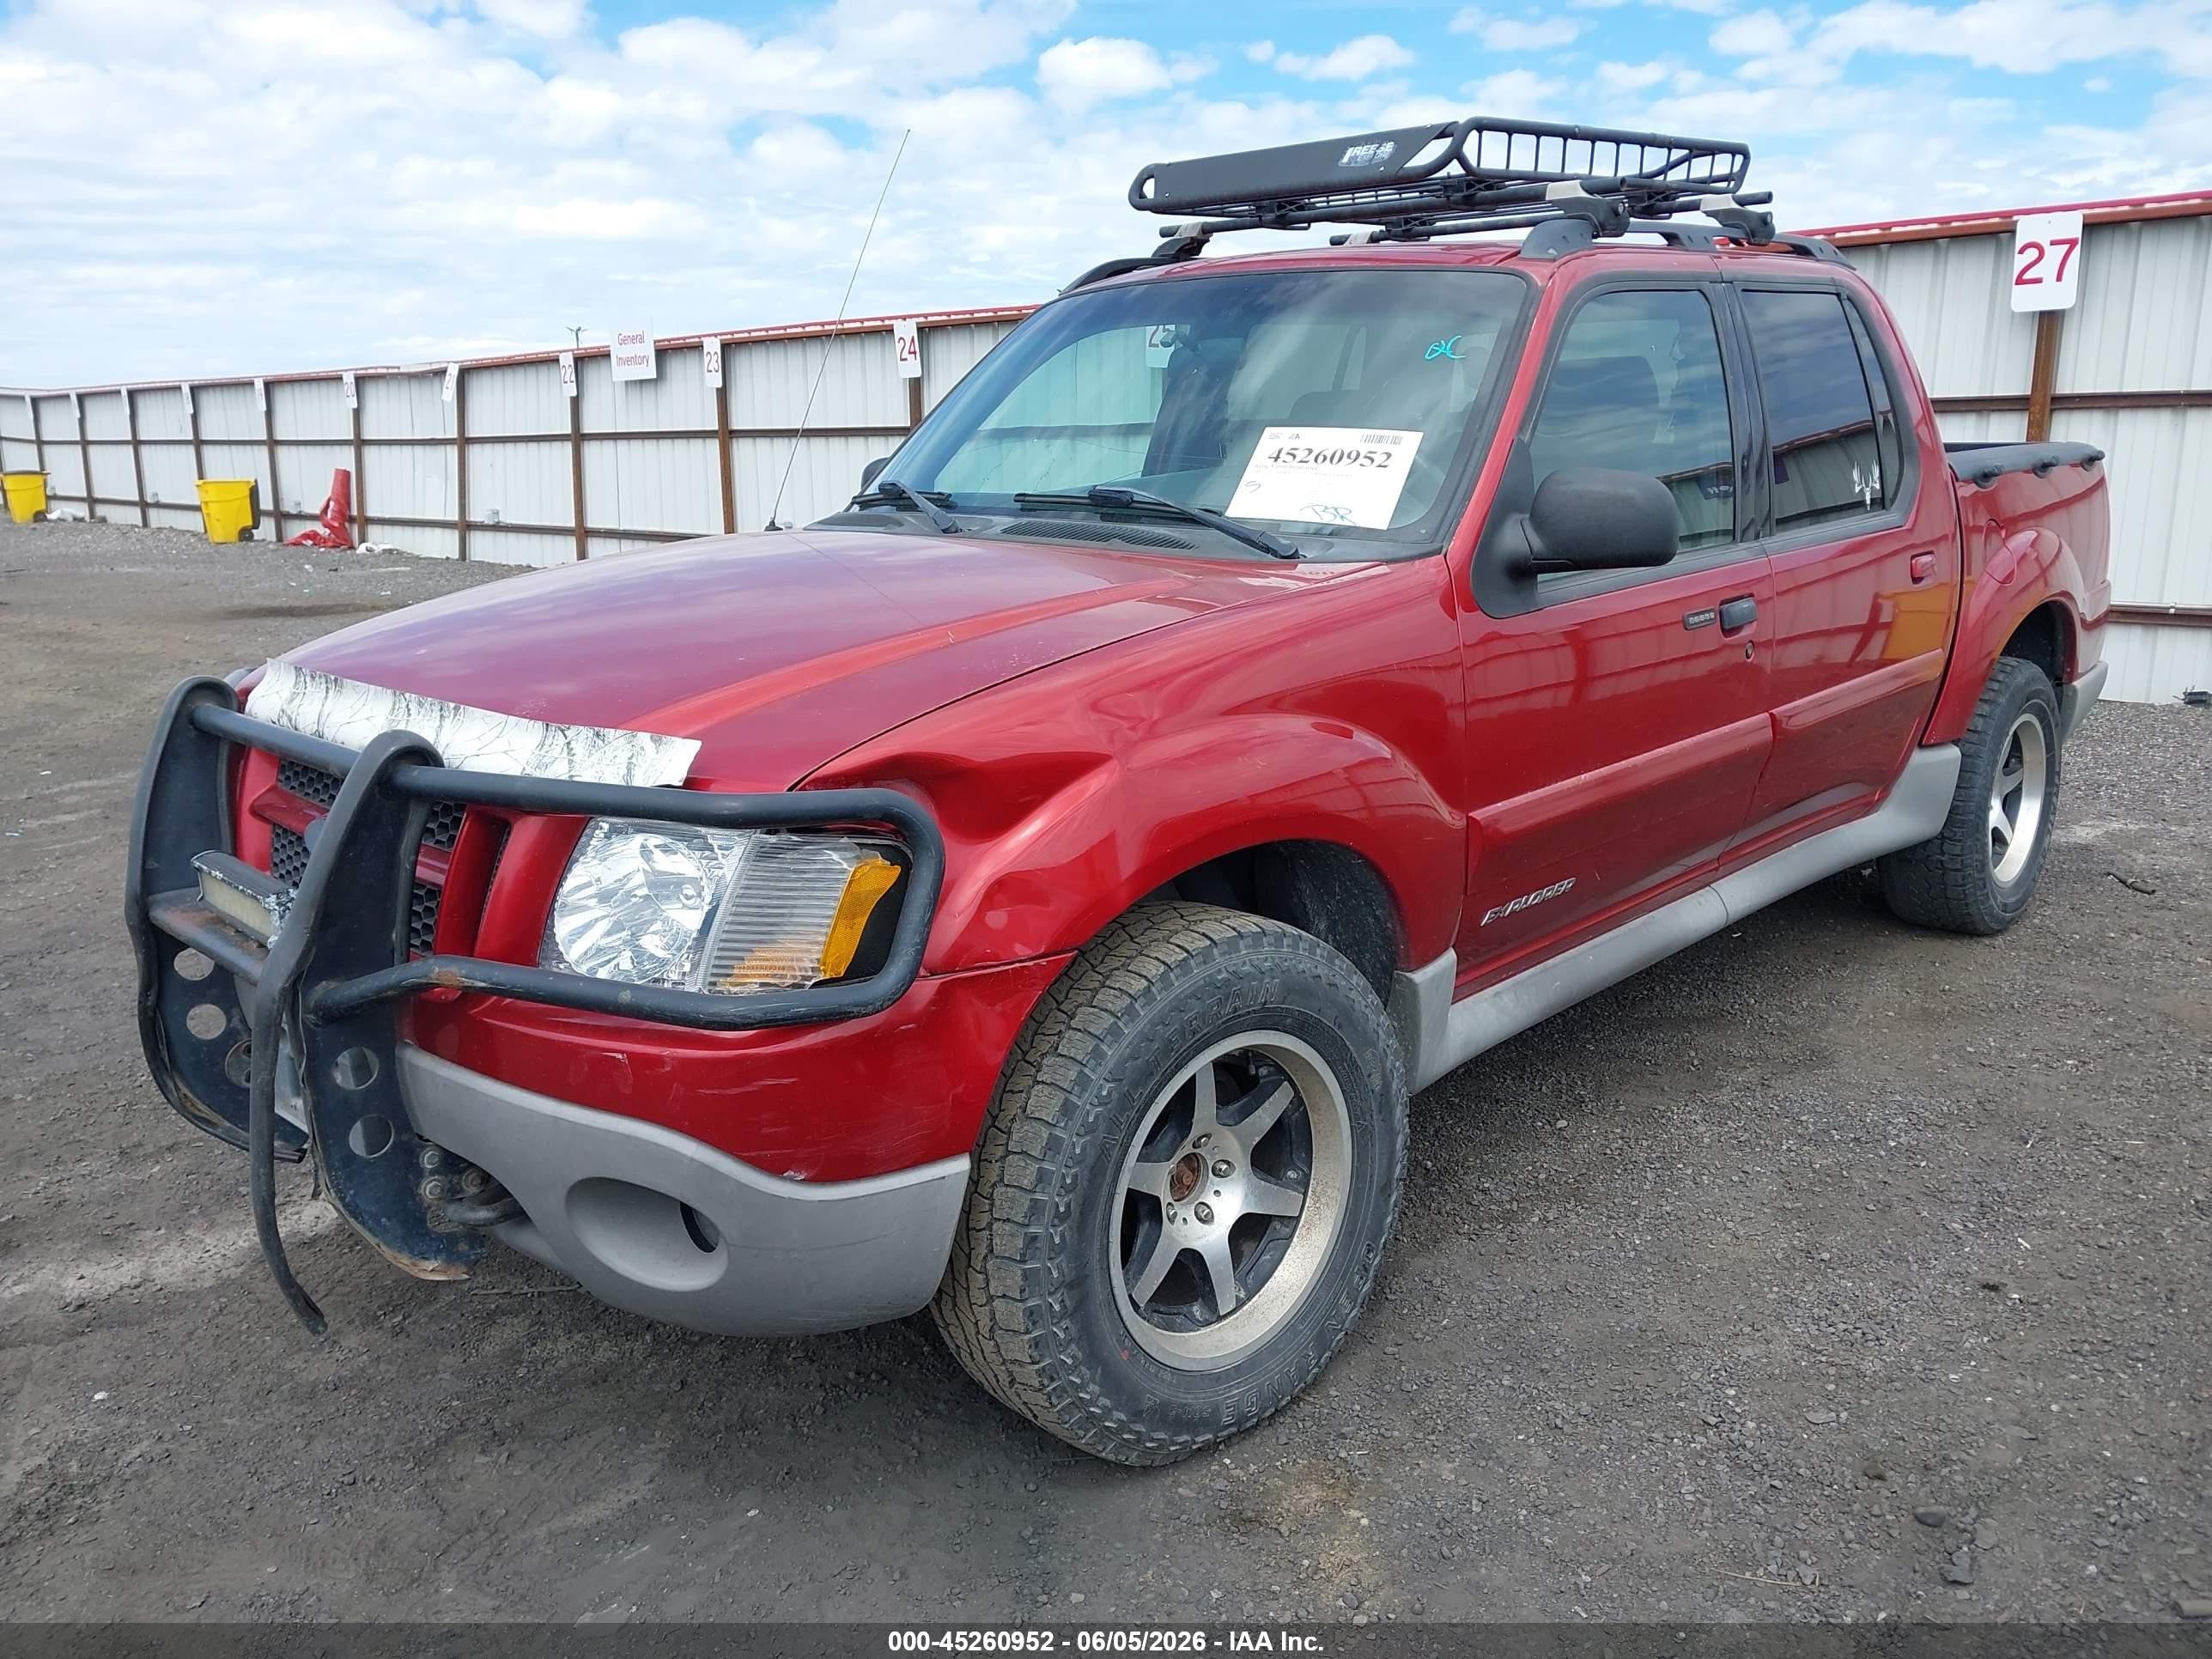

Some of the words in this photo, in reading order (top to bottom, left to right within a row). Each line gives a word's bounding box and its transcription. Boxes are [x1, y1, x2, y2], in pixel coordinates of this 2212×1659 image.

[2014, 236, 2080, 286] 27
[617, 331, 645, 346] General
[897, 335, 917, 362] 24
[616, 354, 650, 368] Inventory
[705, 350, 720, 374] 23
[561, 364, 574, 385] 22
[1267, 447, 1393, 469] 45260952
[1480, 877, 1577, 927] EXPLORER
[1148, 978, 1280, 1073] TERRAIN
[1220, 1341, 1319, 1427] RANGE
